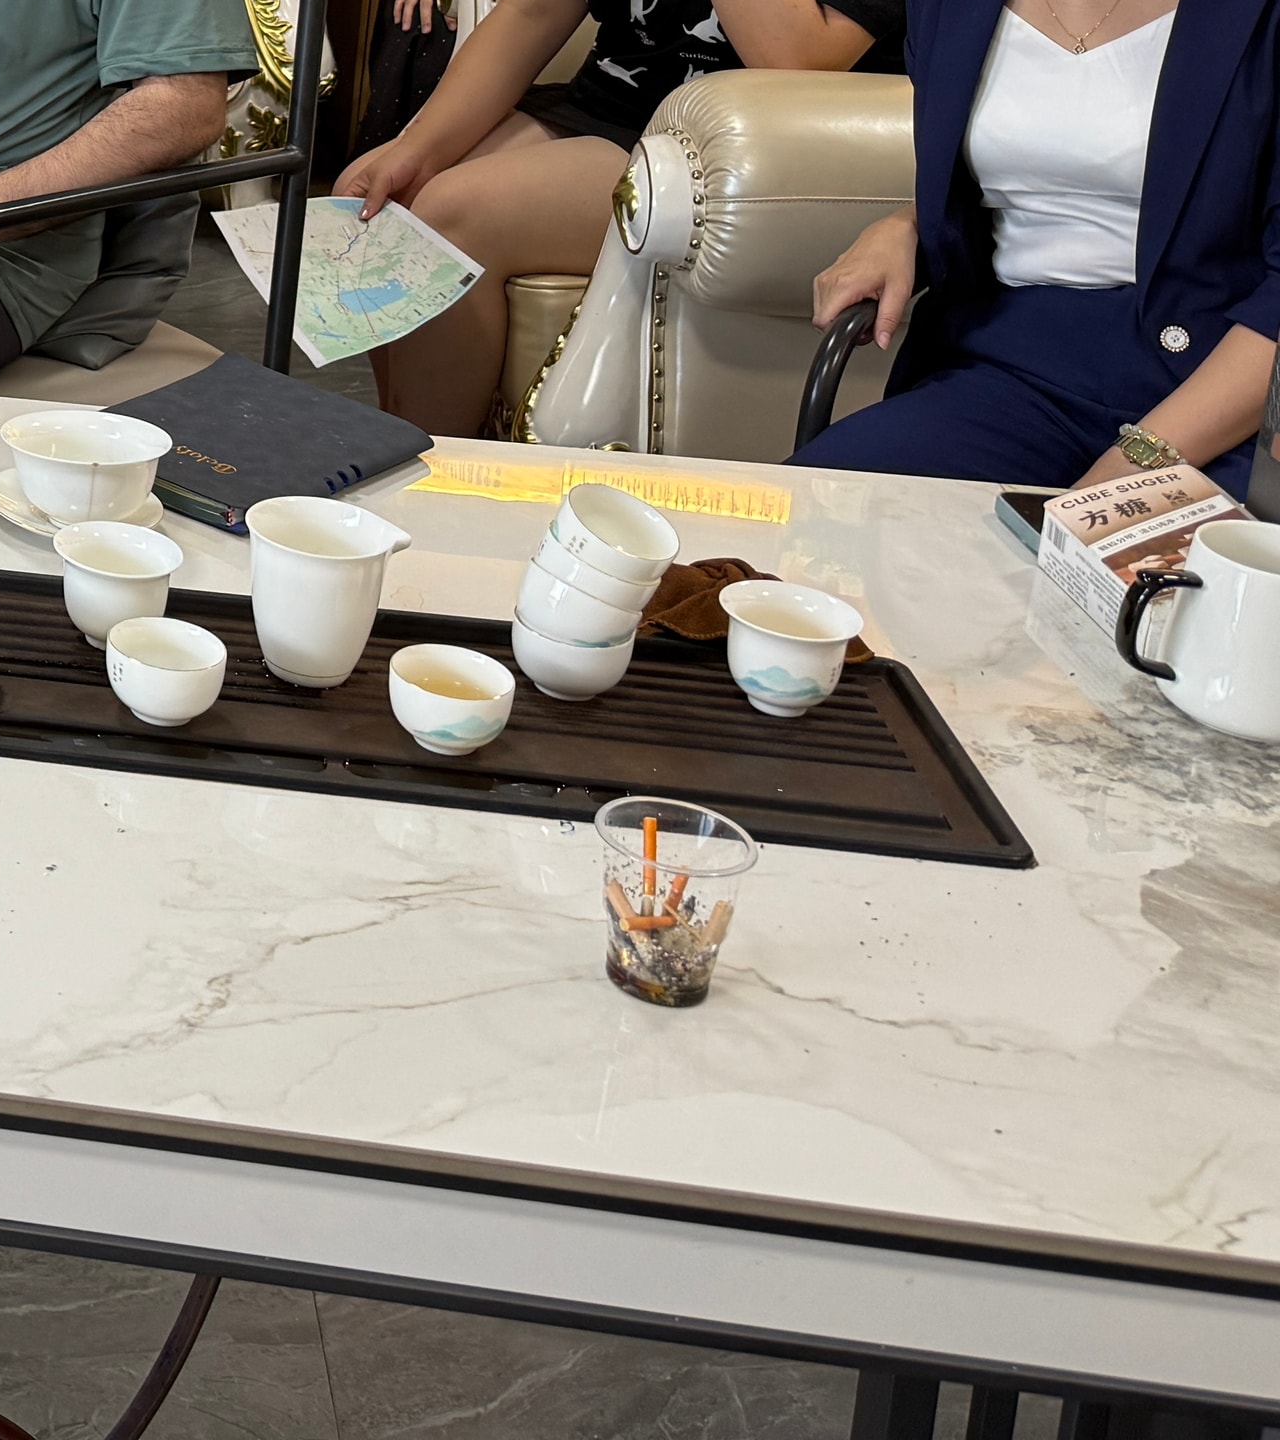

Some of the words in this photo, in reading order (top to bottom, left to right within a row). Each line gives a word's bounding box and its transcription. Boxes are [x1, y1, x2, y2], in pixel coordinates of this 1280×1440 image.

[1060, 488, 1113, 510] CUBE
[1115, 472, 1182, 493] SUGER
[1078, 497, 1153, 531] 方糖
